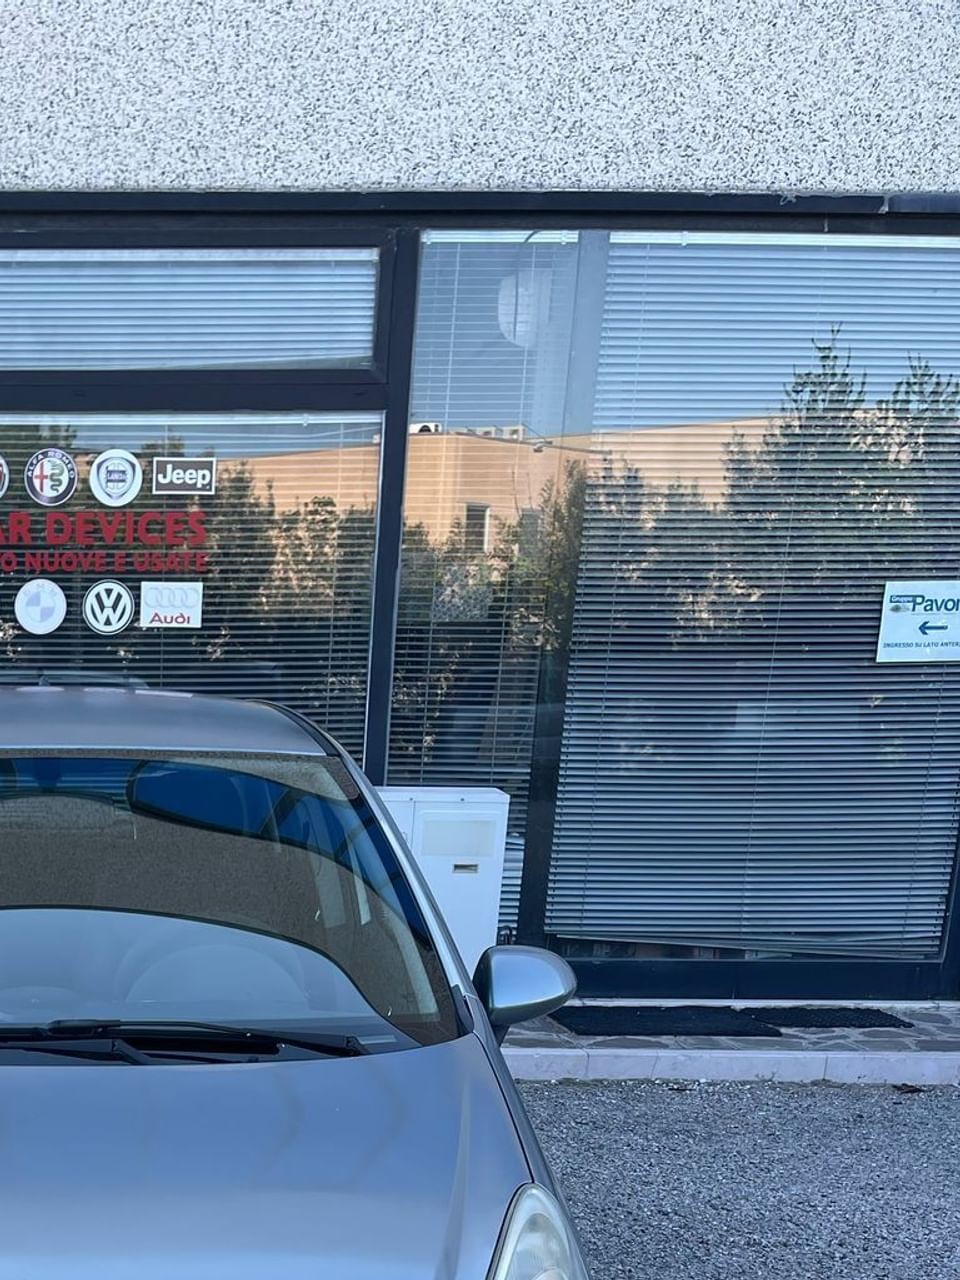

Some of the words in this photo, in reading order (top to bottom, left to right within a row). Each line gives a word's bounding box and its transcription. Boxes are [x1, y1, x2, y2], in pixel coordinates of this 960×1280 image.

[27, 454, 44, 477] ALFA
[47, 451, 75, 479] ROMEO
[157, 463, 211, 489] Jeep
[45, 512, 208, 546] DEVICES
[25, 552, 106, 573] NUOVE
[114, 552, 126, 573] E
[133, 552, 208, 573] USATE
[149, 612, 190, 625] Audi
